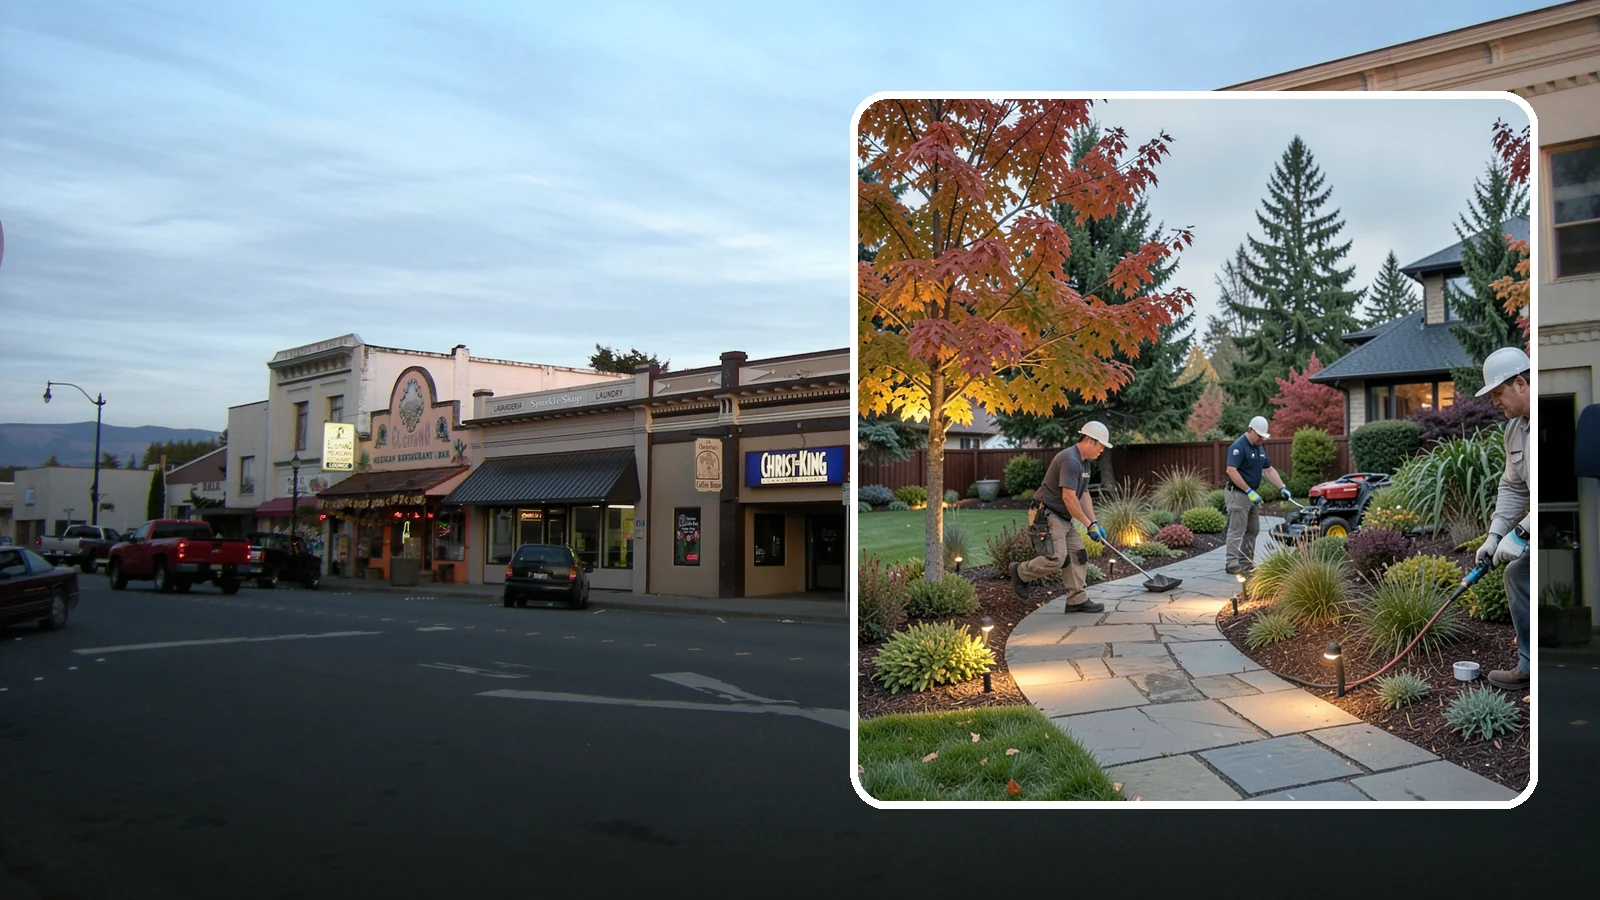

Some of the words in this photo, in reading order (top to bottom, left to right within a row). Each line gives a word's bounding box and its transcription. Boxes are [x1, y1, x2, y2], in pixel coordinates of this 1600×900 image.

[531, 396, 561, 409] Sparkle
[562, 394, 583, 405] Shop
[595, 389, 624, 400] LAUNDRY
[493, 402, 522, 412] LAVANDERIA
[373, 455, 396, 464] MEXICAN
[398, 451, 433, 463] RESTAURANT
[438, 450, 450, 460] BAR
[761, 452, 797, 478] CHRIST
[799, 450, 828, 476] KING
